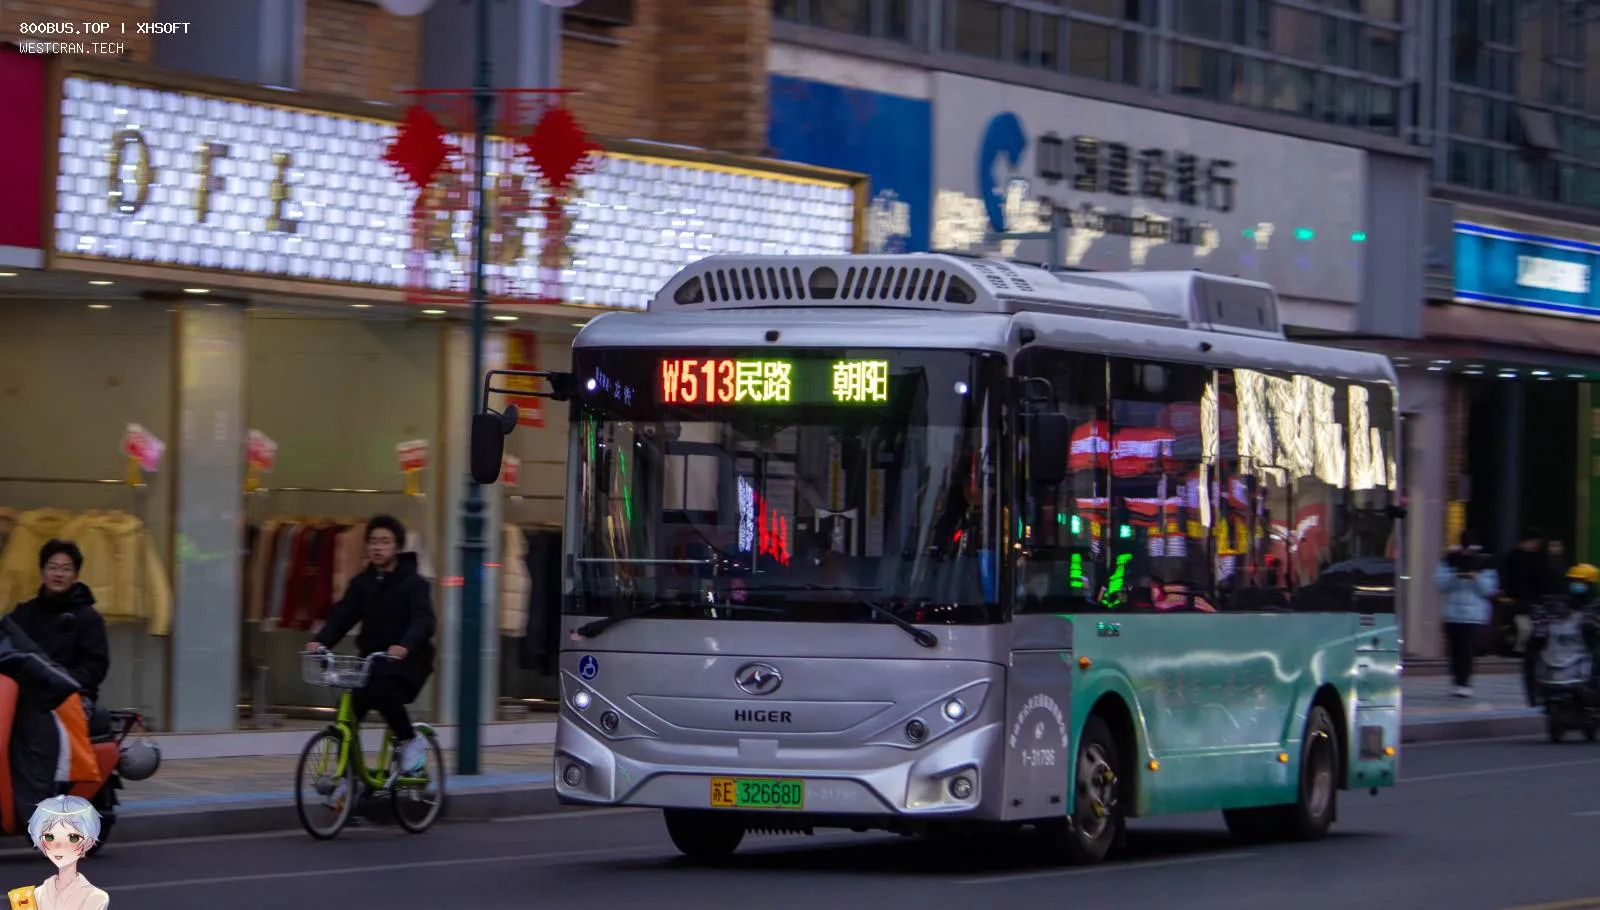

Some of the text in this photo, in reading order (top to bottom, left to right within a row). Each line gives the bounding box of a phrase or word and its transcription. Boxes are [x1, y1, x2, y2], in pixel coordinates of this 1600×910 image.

[661, 359, 735, 403] W513
[735, 360, 792, 402] 民路
[831, 360, 888, 402] 朝阳
[734, 709, 793, 723] HIGER
[740, 782, 802, 805] 32668D
